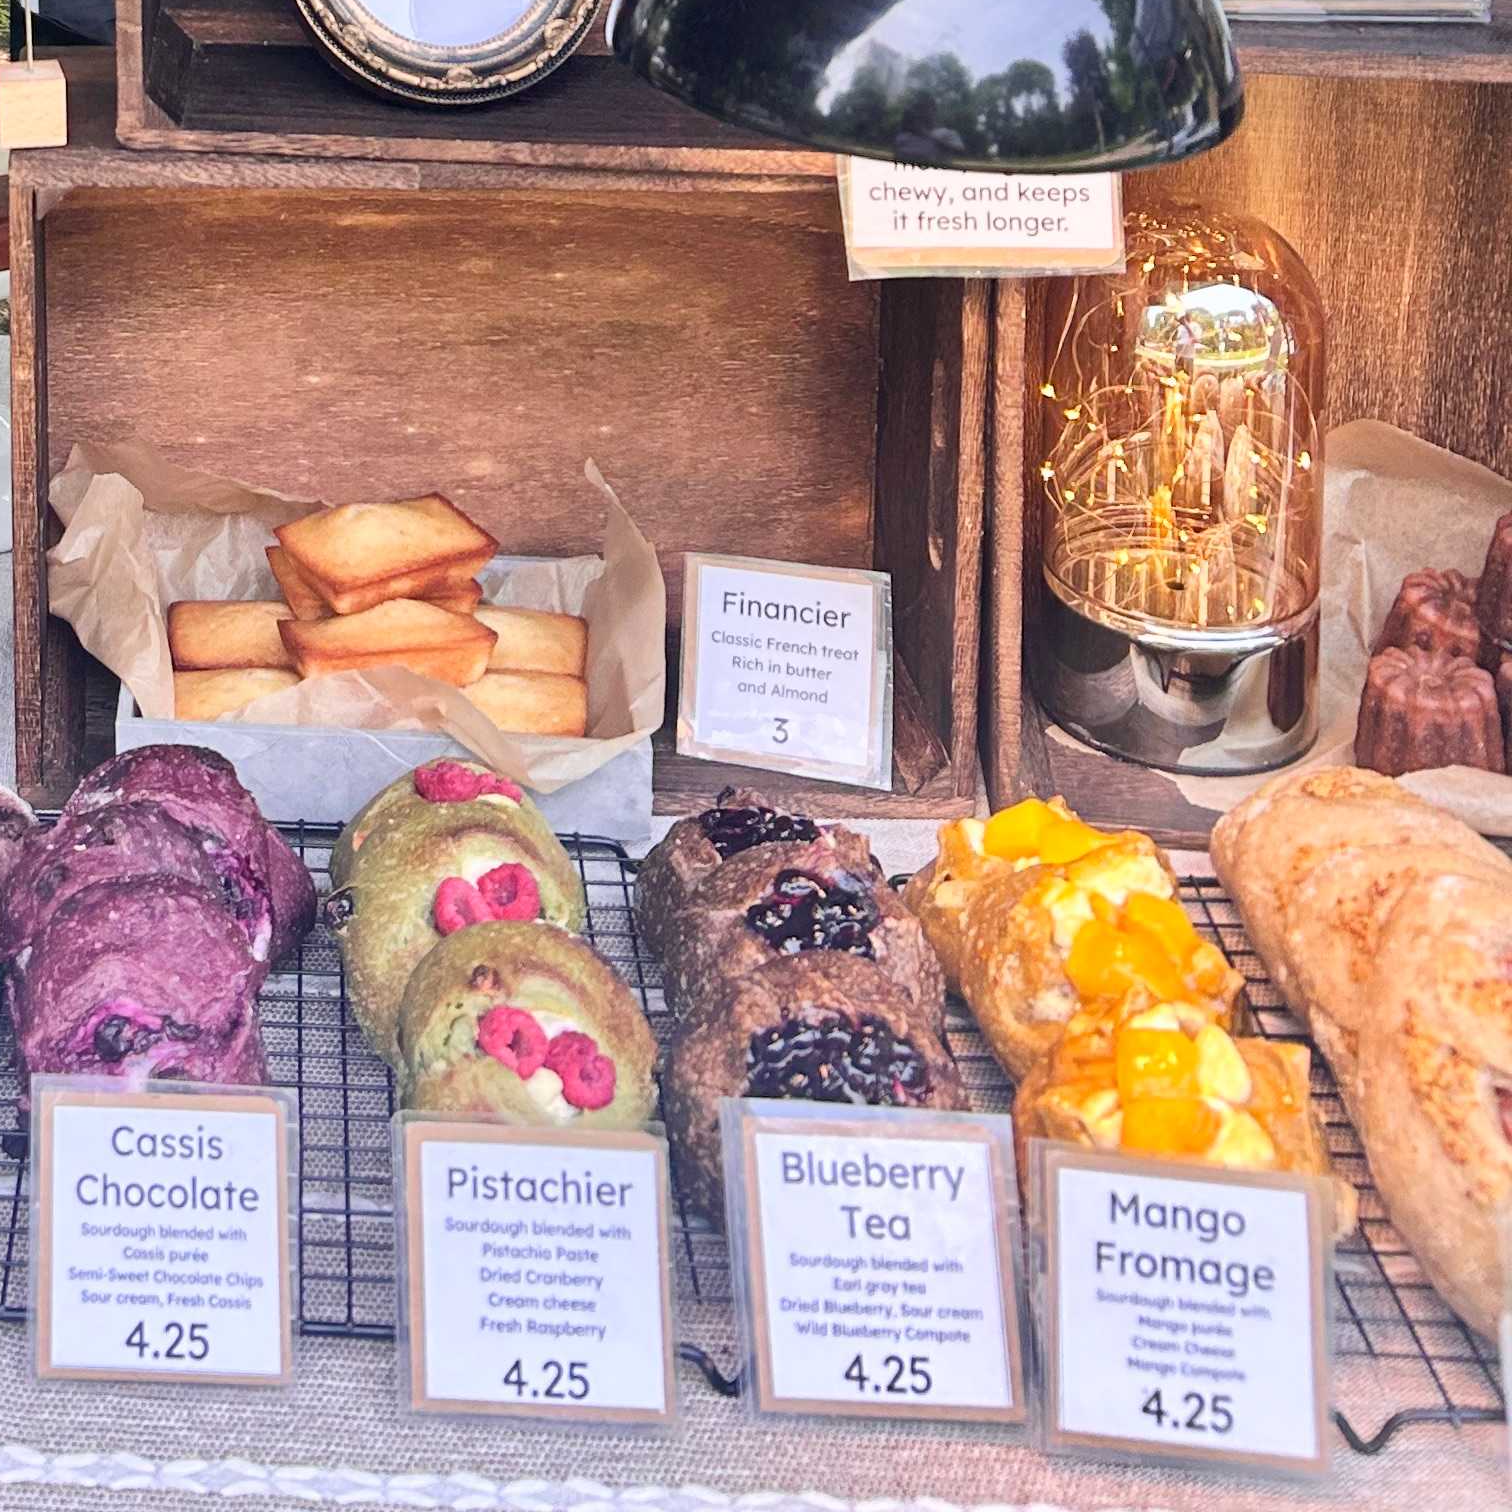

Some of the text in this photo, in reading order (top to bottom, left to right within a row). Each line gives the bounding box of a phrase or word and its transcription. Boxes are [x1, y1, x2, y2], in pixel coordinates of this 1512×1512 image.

[869, 182, 1090, 207] chewy, and keeps
[892, 210, 1070, 237] it fresh longer.
[723, 591, 851, 628] Financier
[711, 630, 859, 661] Classic French treat
[732, 656, 832, 680] Rich in butter
[738, 680, 828, 704] and Almond
[772, 718, 789, 744] 3
[111, 1125, 224, 1160] Cassis
[448, 1165, 633, 1206] Pistachier
[782, 1151, 965, 1201] Blueberry
[76, 1173, 260, 1212] Chocolate
[445, 1217, 631, 1240] Sourdough blended with
[840, 1206, 911, 1240] Tea
[1110, 1190, 1246, 1243] Mango
[81, 1222, 247, 1241] Sourdough blended with
[123, 1246, 165, 1261] Cassis
[482, 1244, 599, 1262] Pistachio Paste
[790, 1252, 963, 1273] Sourdough blended with
[153, 1270, 222, 1285] Chocolate
[225, 1272, 263, 1289] Chips
[480, 1268, 604, 1292] Dried Cranberry
[1095, 1241, 1275, 1297] Fromage
[81, 1290, 252, 1310] Sour Fresh Cassis
[488, 1292, 596, 1312] Cream cheese
[780, 1298, 983, 1321] Dried Sour cream
[125, 1320, 210, 1360] 4.25
[480, 1316, 606, 1341] Fresh Raspberry
[794, 1320, 971, 1344] Wild Blueberry Compote
[503, 1358, 590, 1399] 4.25
[844, 1354, 933, 1394] 4.25
[1141, 1388, 1233, 1433] 4.25
